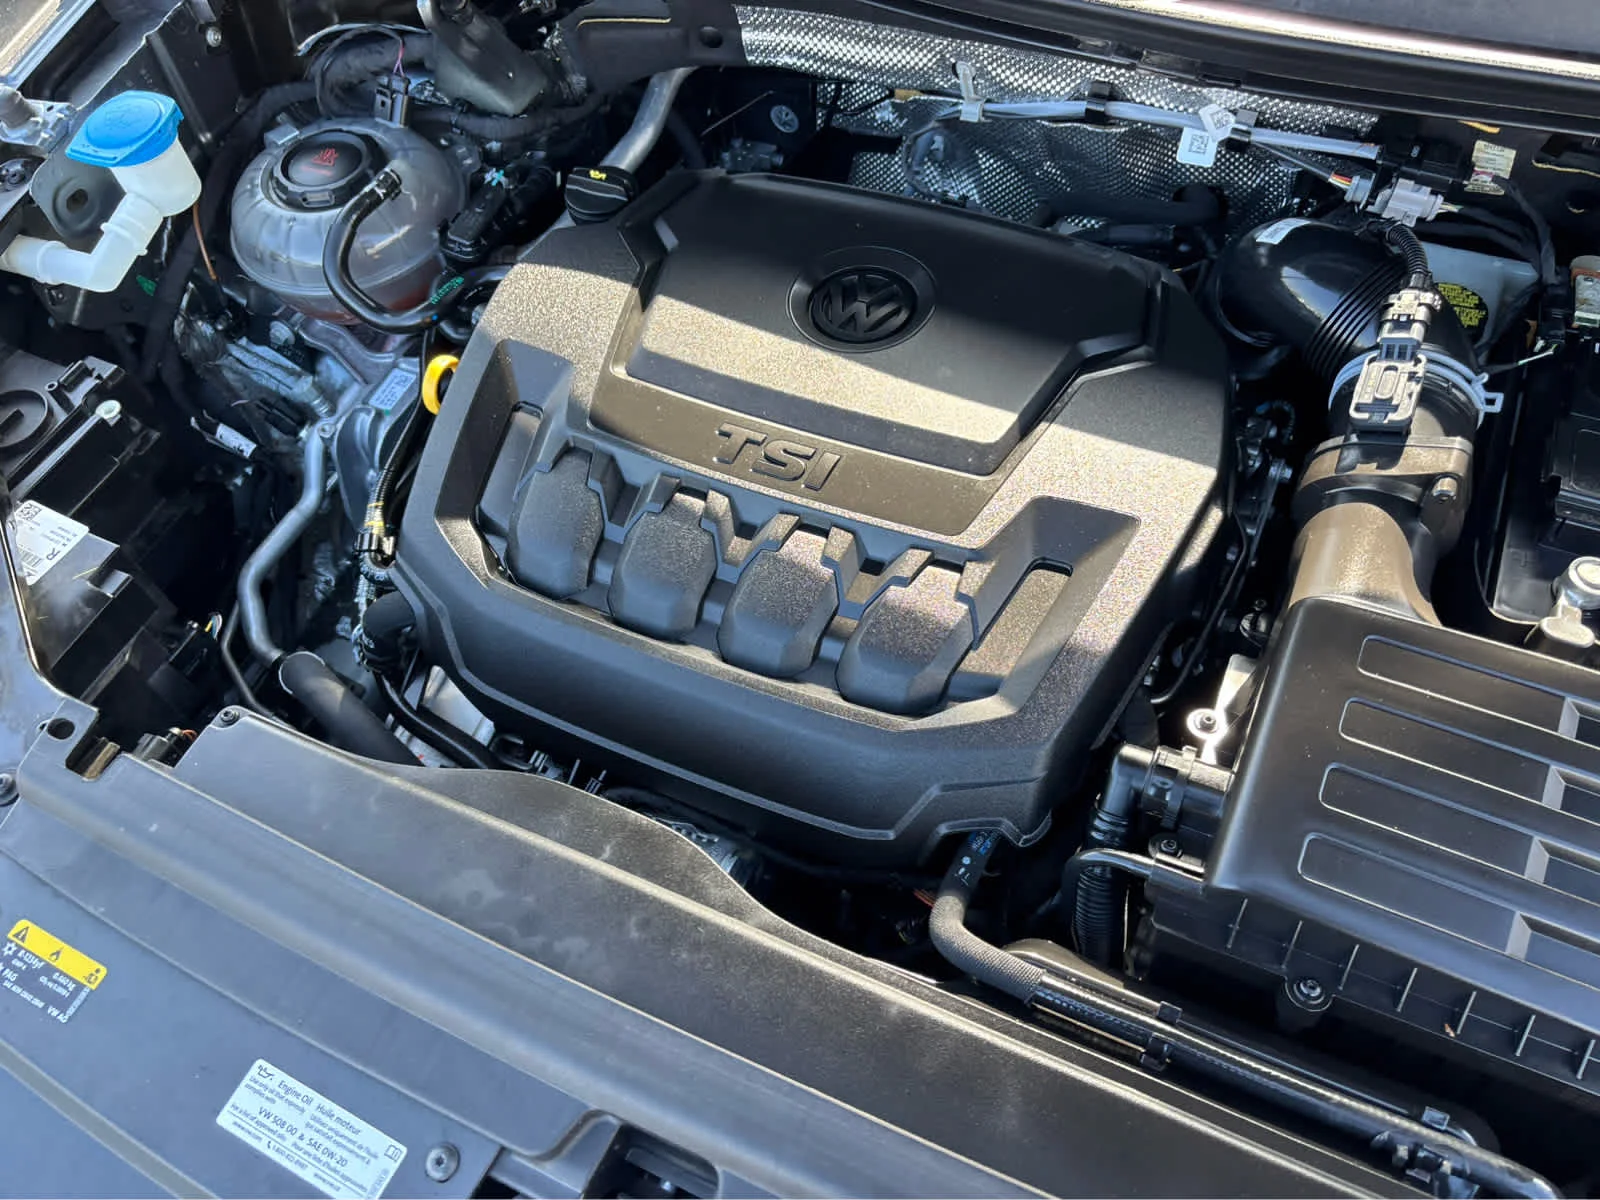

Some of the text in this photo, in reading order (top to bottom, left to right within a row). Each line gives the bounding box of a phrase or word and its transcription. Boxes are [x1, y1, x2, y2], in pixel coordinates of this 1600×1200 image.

[713, 422, 842, 491] TSI
[2, 968, 18, 981] PAG
[277, 1080, 314, 1106] Engine Oil
[315, 1104, 361, 1135] Huile moteur
[258, 1106, 348, 1167] VW 508 00 & SAE 0W-20
